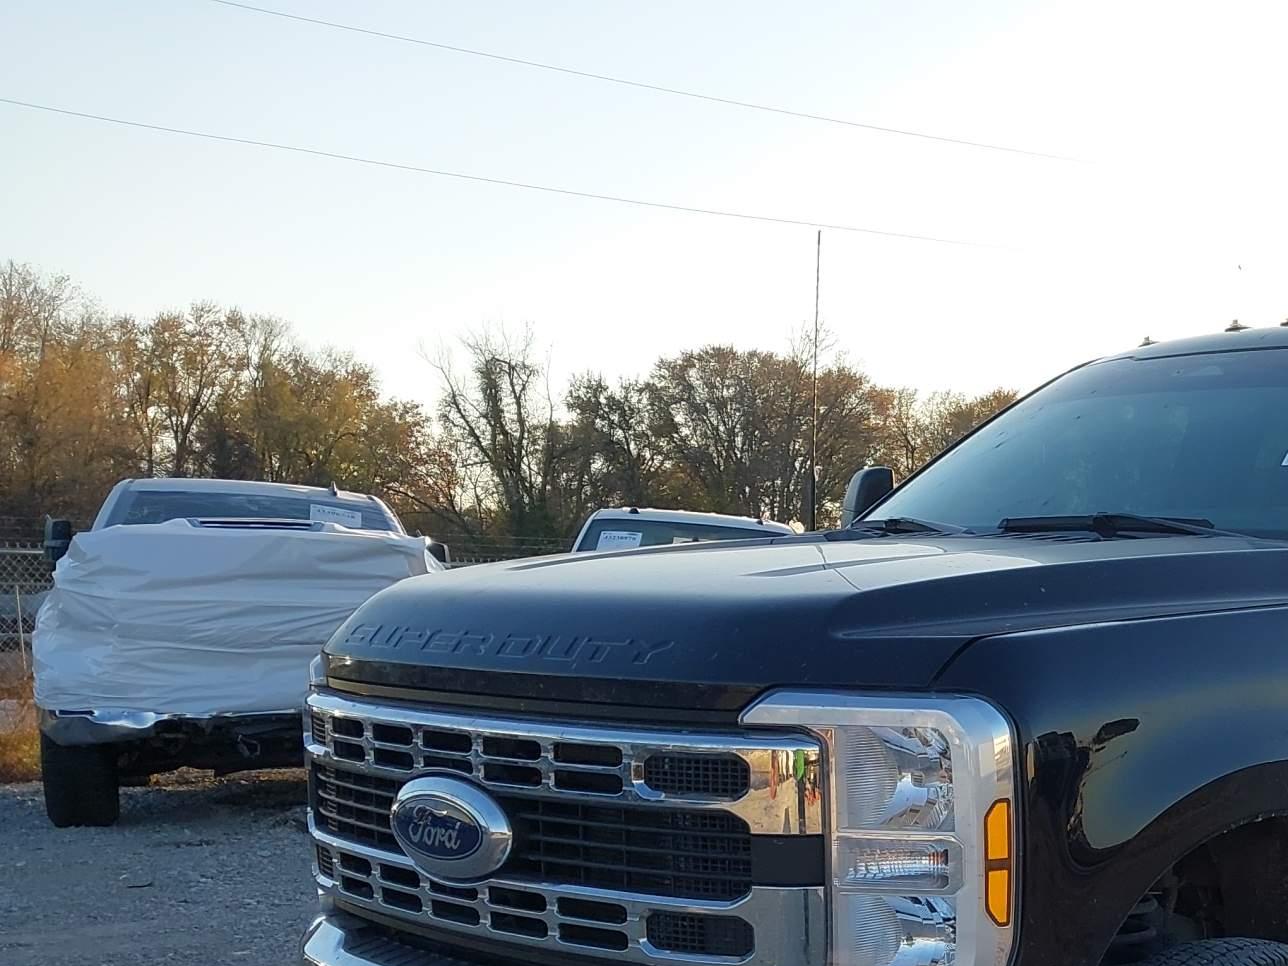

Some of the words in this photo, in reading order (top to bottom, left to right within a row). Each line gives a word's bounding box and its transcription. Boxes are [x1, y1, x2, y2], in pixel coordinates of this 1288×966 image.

[345, 622, 495, 656] SUPER
[496, 631, 674, 667] DUTY
[409, 804, 460, 850] Ford
